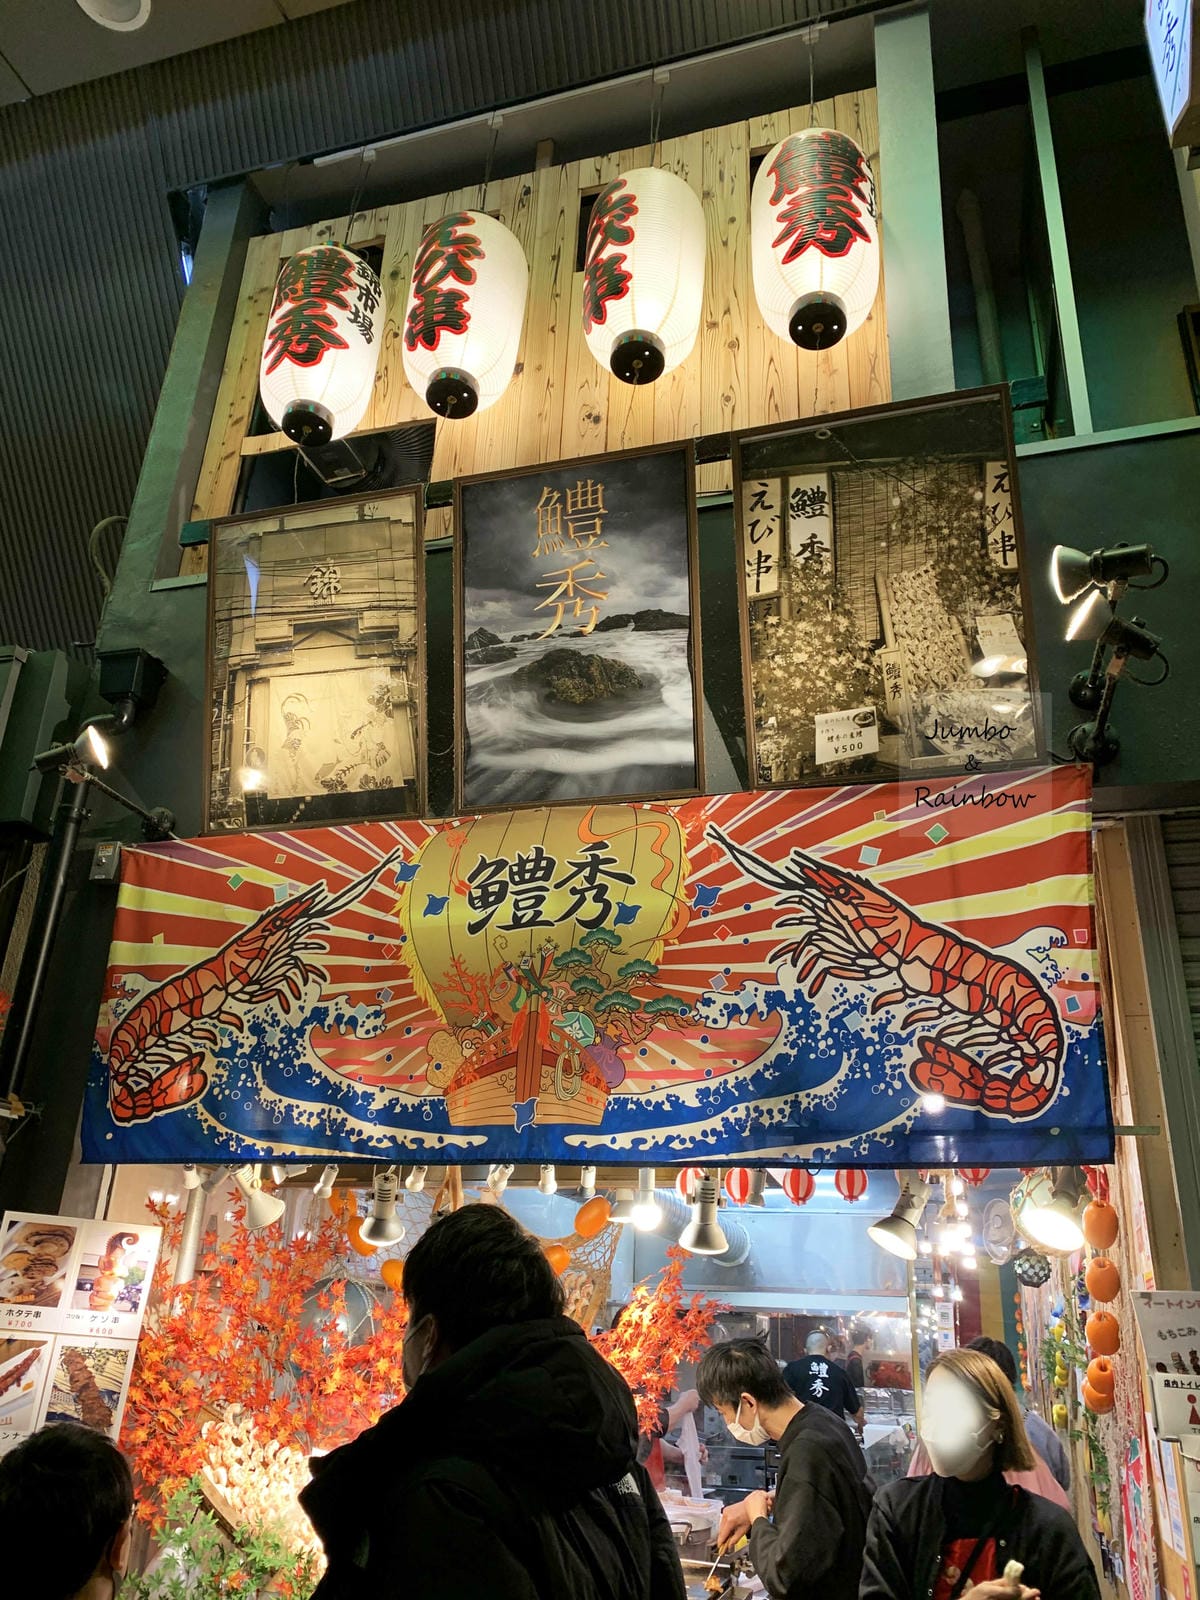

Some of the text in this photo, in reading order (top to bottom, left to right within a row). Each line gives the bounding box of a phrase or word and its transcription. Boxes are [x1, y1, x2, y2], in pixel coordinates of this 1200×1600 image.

[263, 247, 357, 375] 鱧秀
[347, 261, 382, 344] 錦市場
[405, 210, 486, 351] えび串
[531, 479, 609, 641] 鱧秀
[747, 482, 781, 593] えび串
[466, 841, 637, 936] 鱧秀
[809, 1361, 830, 1398] 鱧秀
